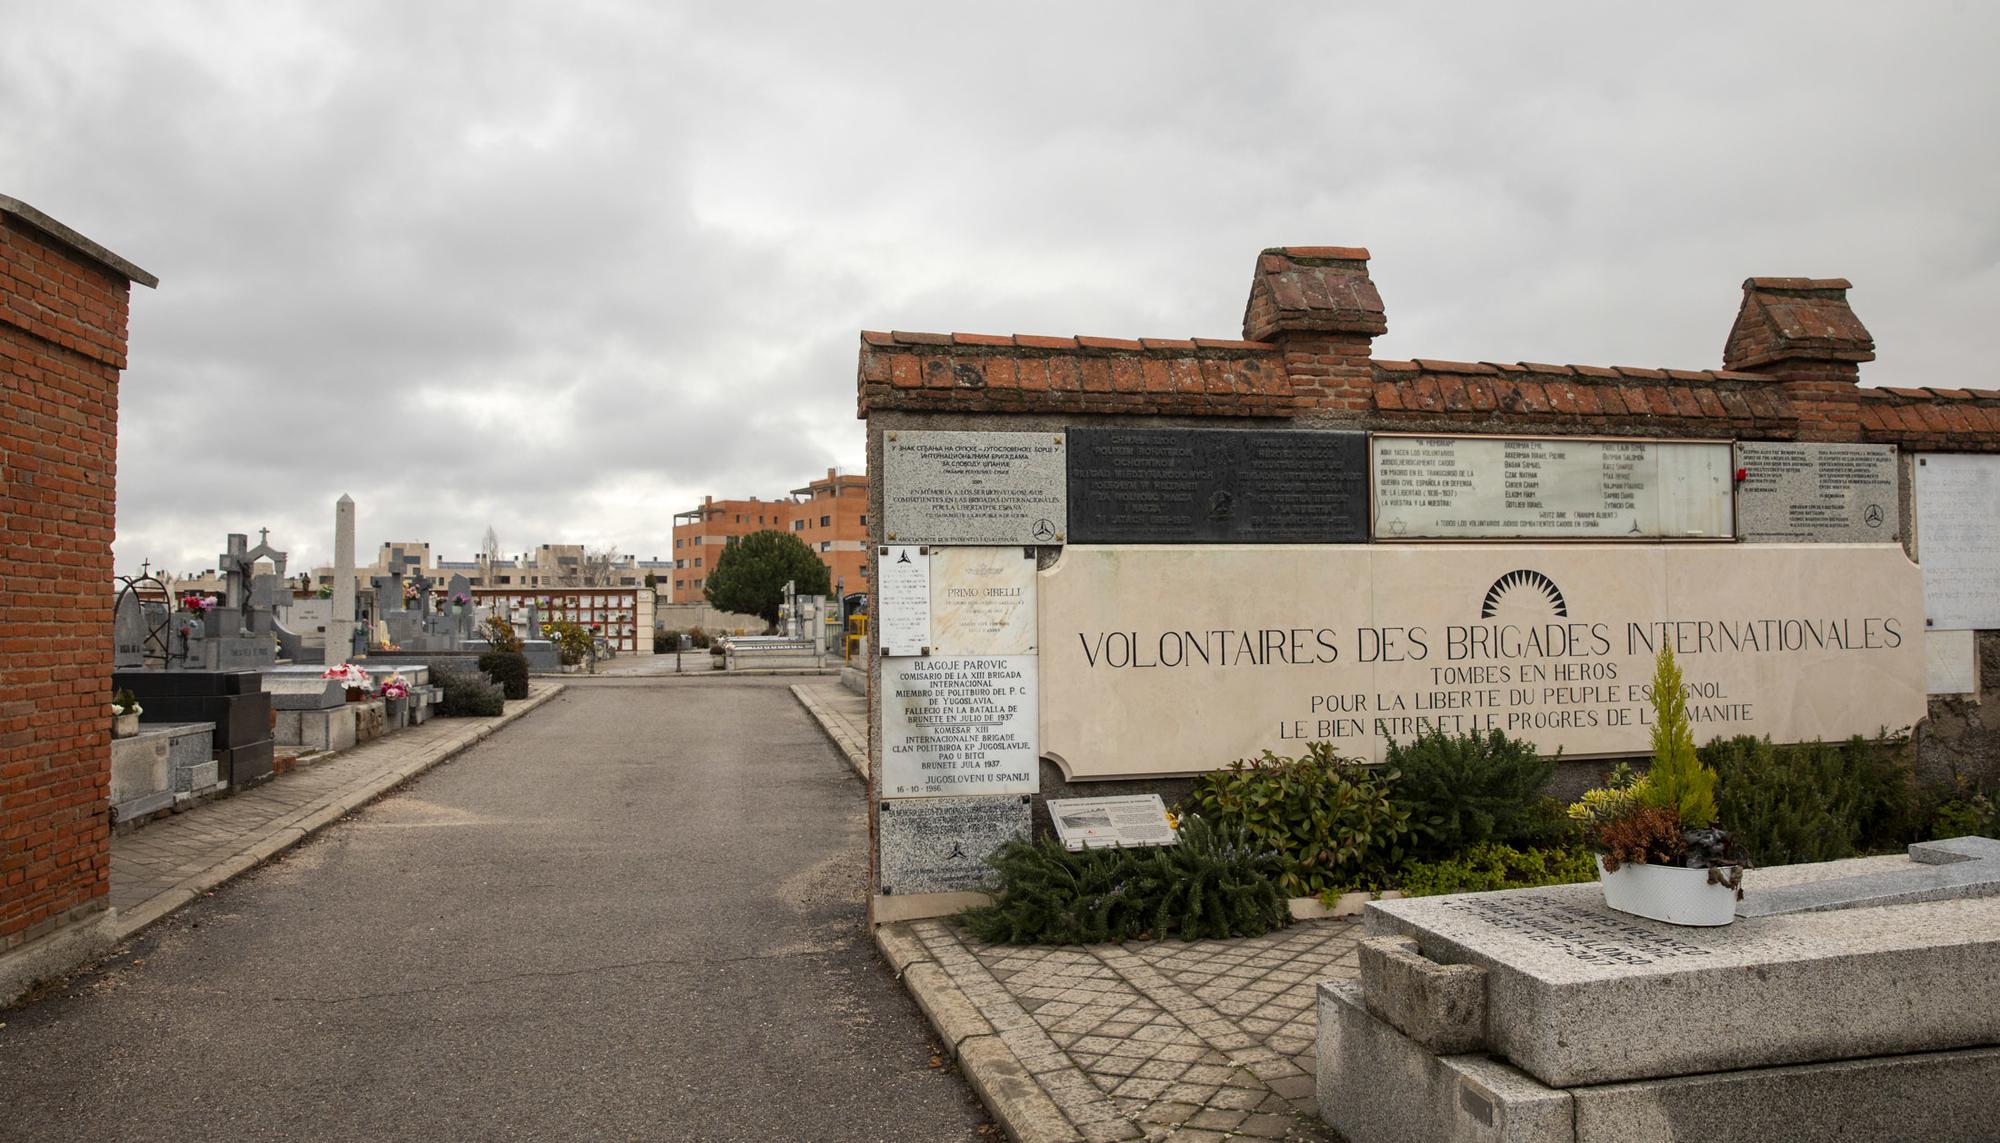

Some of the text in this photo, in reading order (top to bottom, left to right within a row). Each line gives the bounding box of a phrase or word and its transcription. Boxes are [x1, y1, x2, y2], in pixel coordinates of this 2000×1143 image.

[947, 587, 979, 597] PRIMO
[1078, 617, 1902, 668] VOLONTAIRES DES BRIGADES INTERNATIONALES
[914, 660, 1008, 671] BLAGOJE PAROVIC
[900, 671, 1022, 681] COMISARIO DE LA XIII BRIGADA
[1430, 662, 1617, 685] TOMBES EN HEROS
[930, 680, 993, 688] INTERNACIONAL
[896, 689, 933, 698] MIEMBRO
[935, 689, 945, 697] DE
[948, 688, 991, 697] POLITBURO
[992, 688, 1007, 696] DEL
[929, 698, 939, 706] DE
[1311, 694, 1368, 713] POUR
[1377, 693, 1406, 711] LA
[1415, 690, 1501, 710] LIBERTE
[1510, 688, 1535, 706] DU
[1543, 685, 1621, 705] PEUPLE
[905, 707, 941, 715] FALLECIO
[943, 706, 954, 714] EN
[956, 706, 968, 714] LA
[1008, 705, 1018, 713] DE
[907, 715, 944, 724] BRUNETE
[946, 715, 957, 723] EN
[959, 714, 982, 723] JULIO
[984, 714, 994, 722] DE
[1280, 703, 1754, 740] LE BIEN ETRE ET LE PROGRES DE L'MANITE
[934, 725, 989, 734] KOMESAR XIII
[905, 734, 1015, 744] INTERNACIONALNE BRIGADE
[892, 744, 914, 753] CLAN
[916, 743, 962, 752] POLITBIROA
[964, 743, 975, 751] KP
[939, 752, 985, 760] PAO U BITCI
[921, 761, 957, 770] BRUNETE
[960, 761, 981, 769] JULA
[925, 773, 1030, 785] JUGOSLOVENI U SPANIJI
[911, 785, 920, 793] 10
